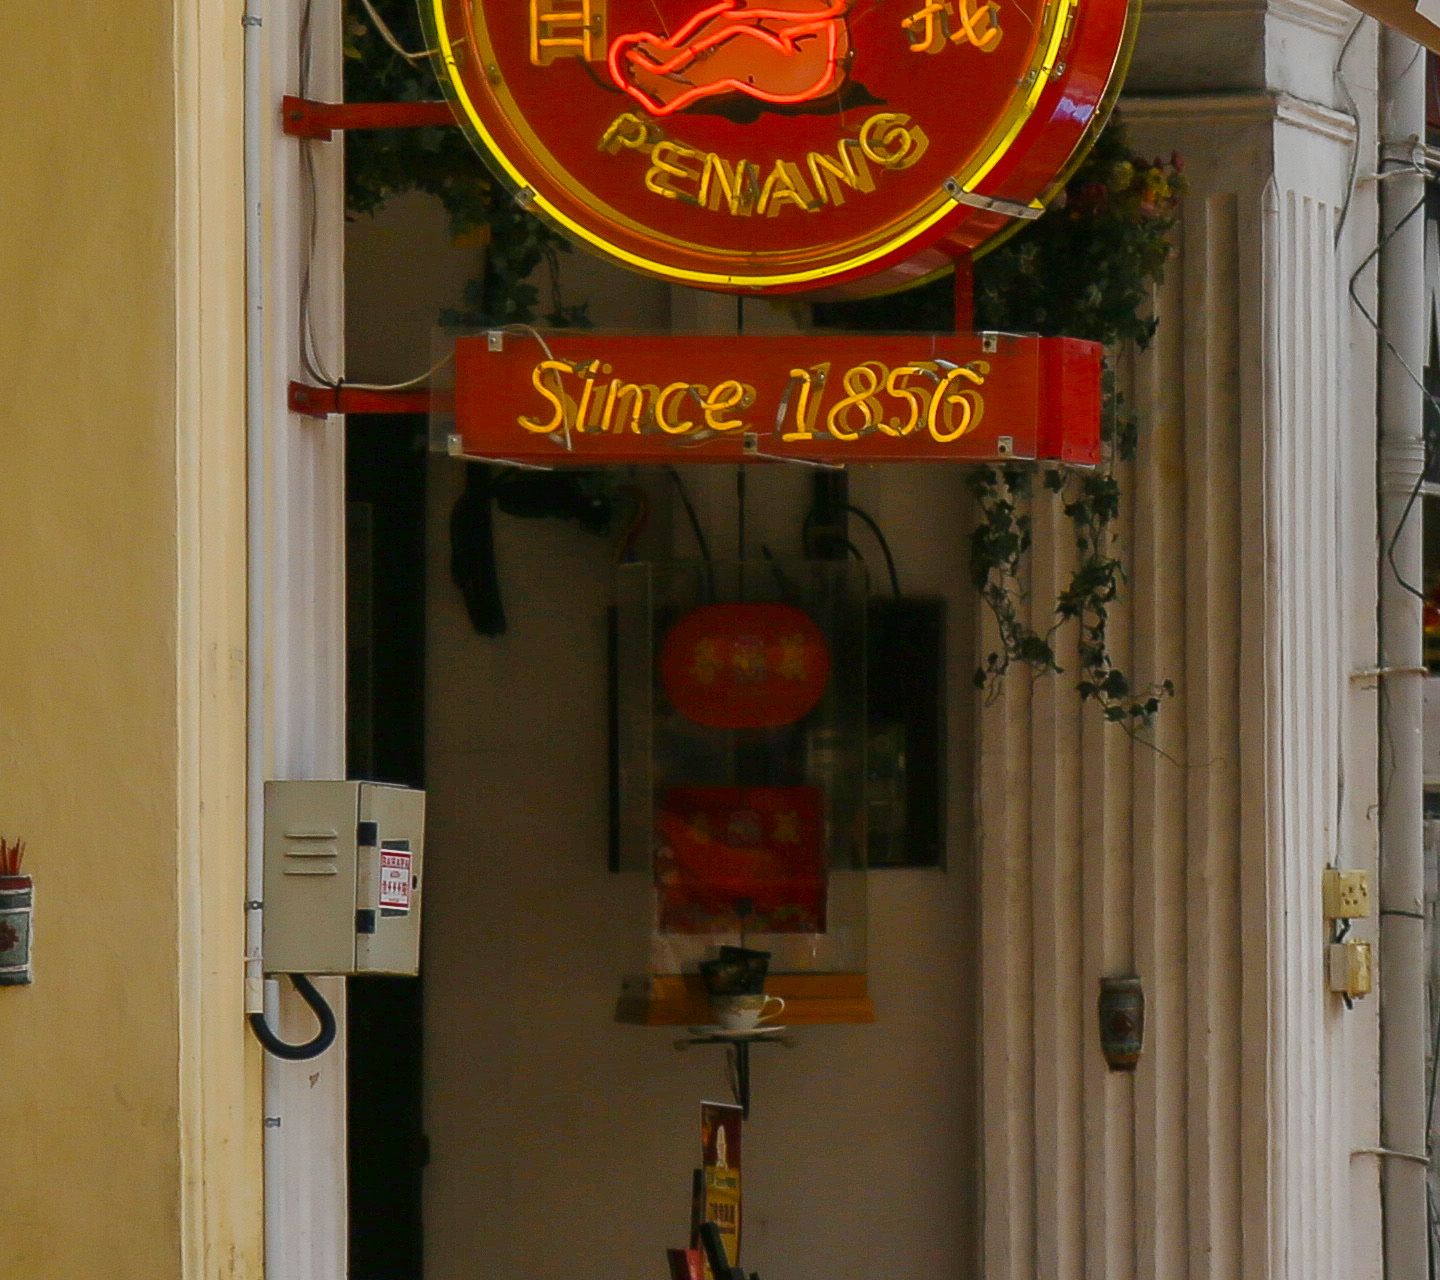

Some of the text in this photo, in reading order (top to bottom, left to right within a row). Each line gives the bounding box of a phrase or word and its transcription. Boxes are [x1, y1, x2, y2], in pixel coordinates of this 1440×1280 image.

[597, 111, 930, 218] PENANG
[518, 357, 991, 443] Since 1856
